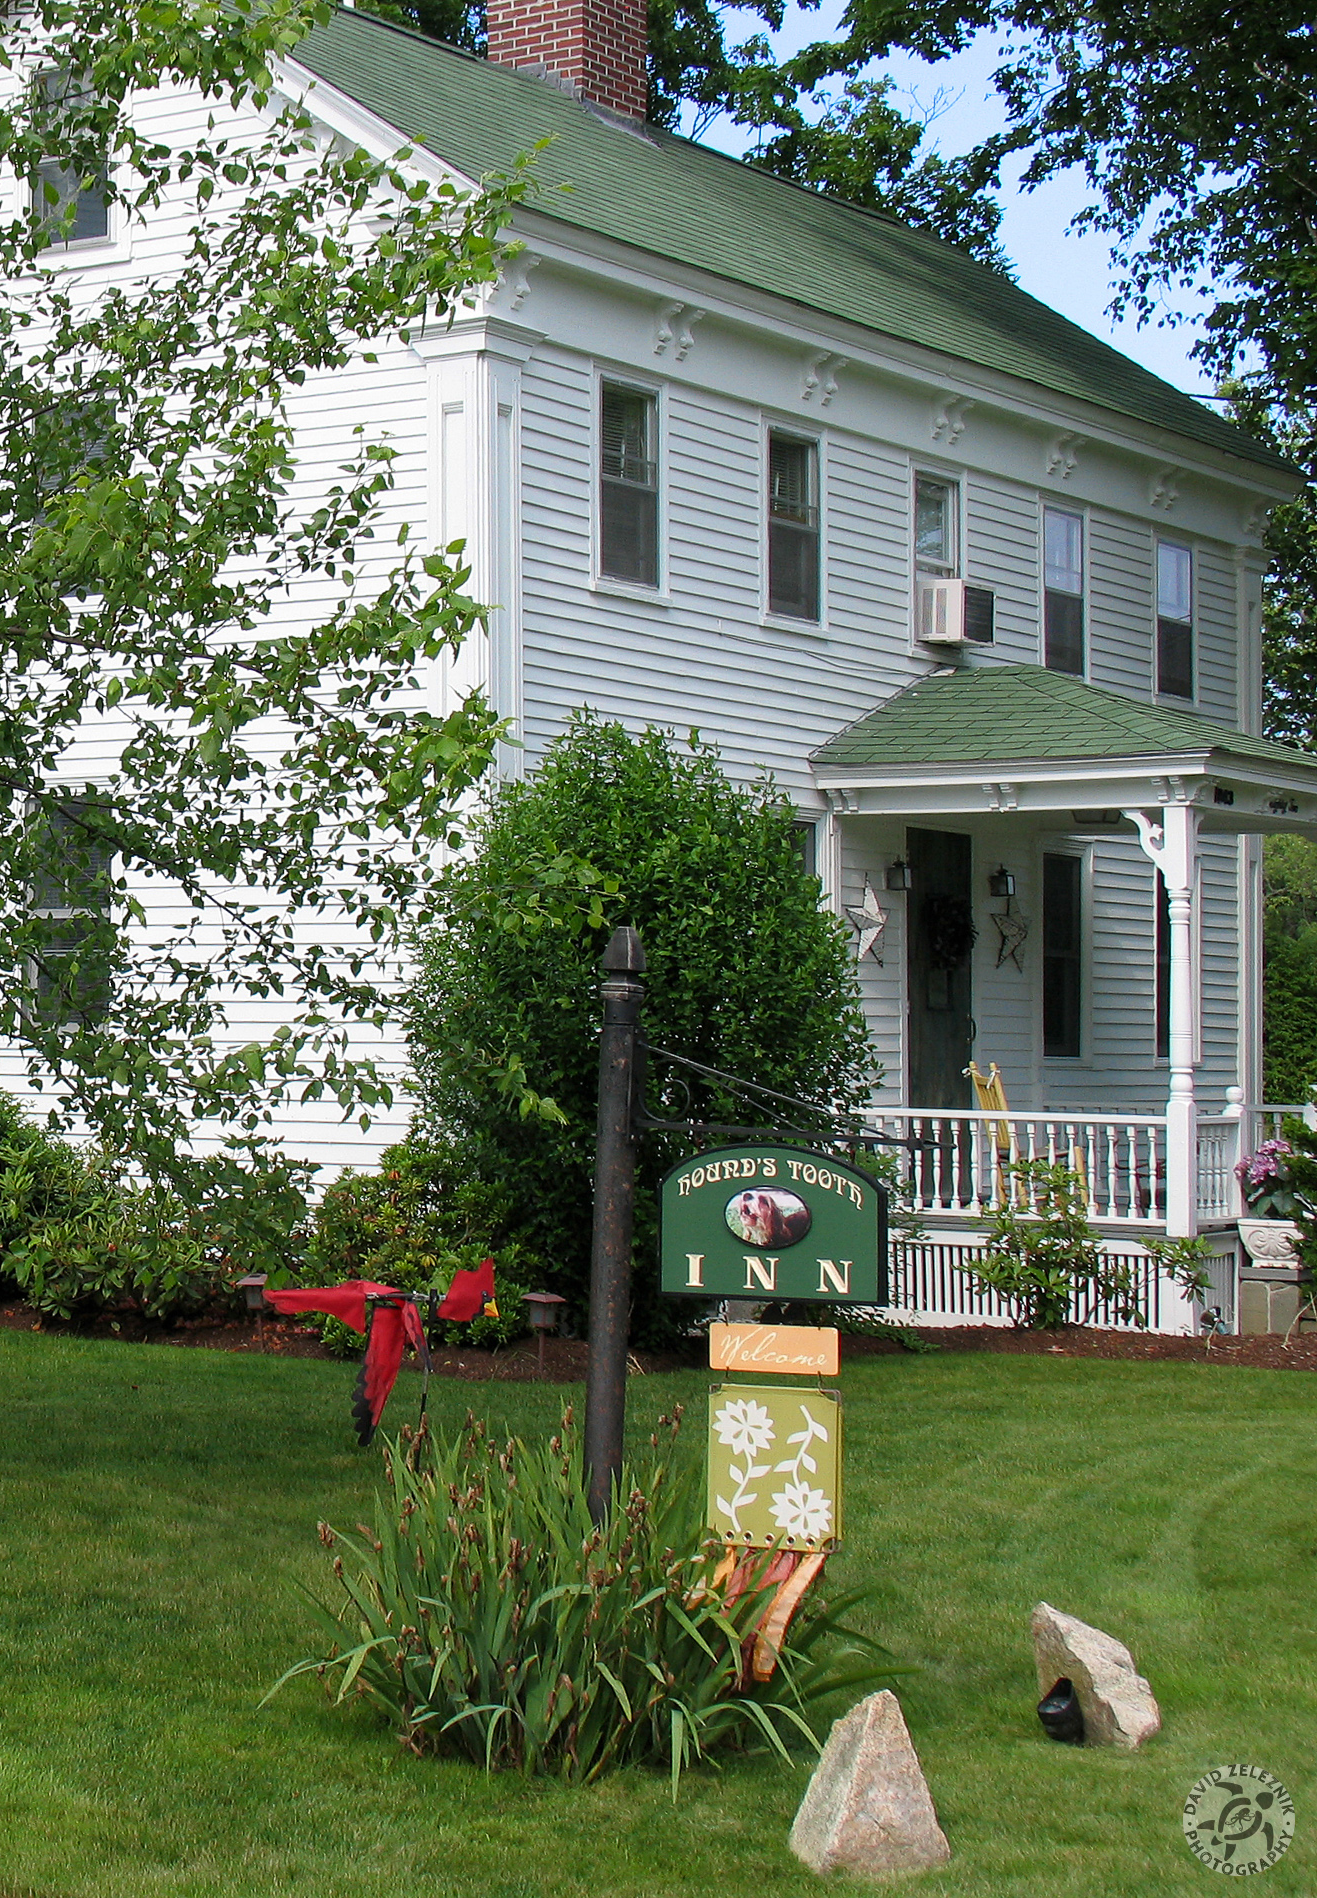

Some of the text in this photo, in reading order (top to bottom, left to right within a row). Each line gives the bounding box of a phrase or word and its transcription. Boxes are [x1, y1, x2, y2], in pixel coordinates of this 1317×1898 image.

[677, 1157, 864, 1210] HOUND'S TOOTH
[720, 1327, 828, 1367] Welcome
